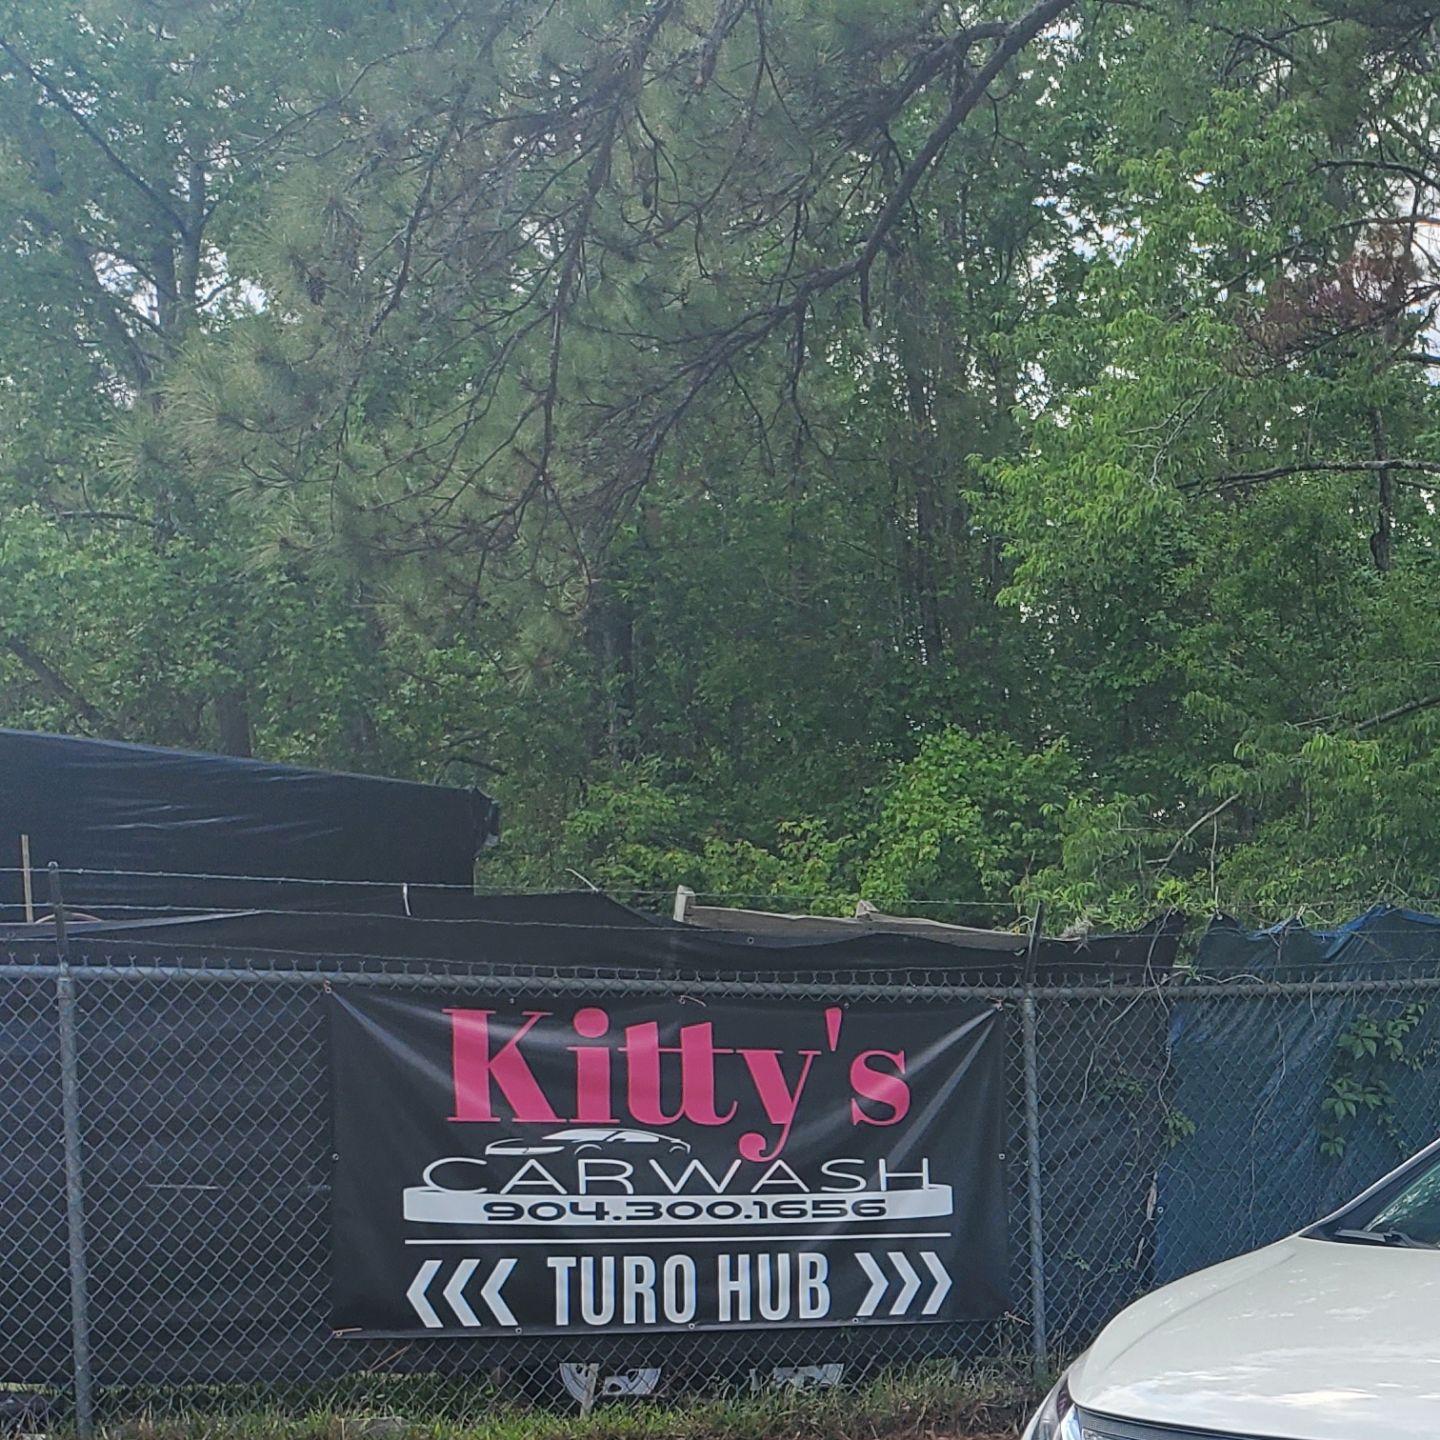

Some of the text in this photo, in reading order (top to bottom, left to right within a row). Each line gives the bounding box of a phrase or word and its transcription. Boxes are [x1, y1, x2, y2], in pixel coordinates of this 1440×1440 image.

[441, 1005, 911, 1163] Kitty's
[482, 1198, 887, 1222] 904.300.1656
[547, 1252, 831, 1326] TURO HUB
